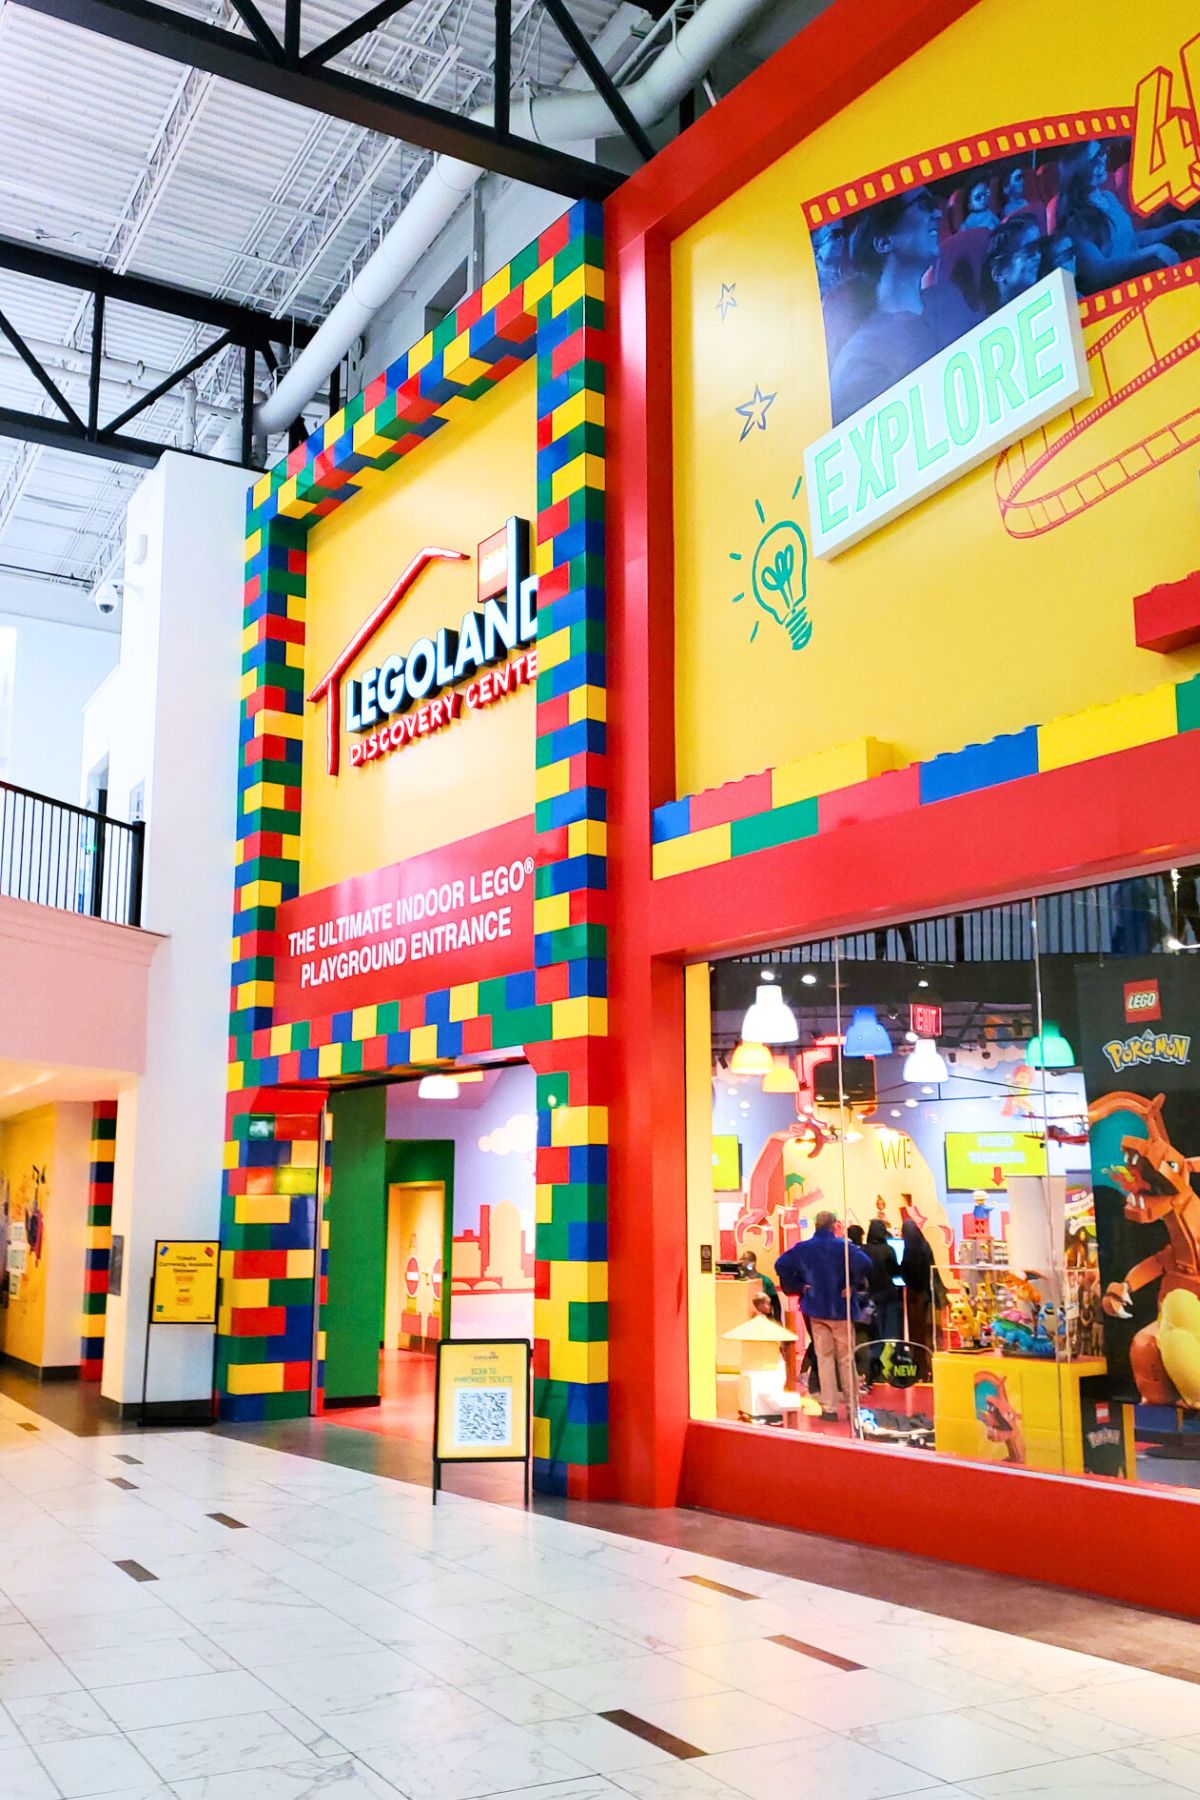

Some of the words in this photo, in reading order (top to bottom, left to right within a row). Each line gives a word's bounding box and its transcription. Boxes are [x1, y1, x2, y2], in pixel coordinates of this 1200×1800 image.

[814, 289, 1065, 535] EXPLORE
[350, 691, 463, 768] DISCOVERY
[288, 927, 316, 957] THE
[319, 902, 393, 949] ULTIMATE
[396, 879, 465, 926] INDOOR
[301, 937, 407, 989] PLAYGROUND
[410, 906, 512, 960] ENTRANCE
[916, 1006, 937, 1032] EXIT
[1127, 991, 1157, 1012] LEGO
[893, 1365, 917, 1377] NEW
